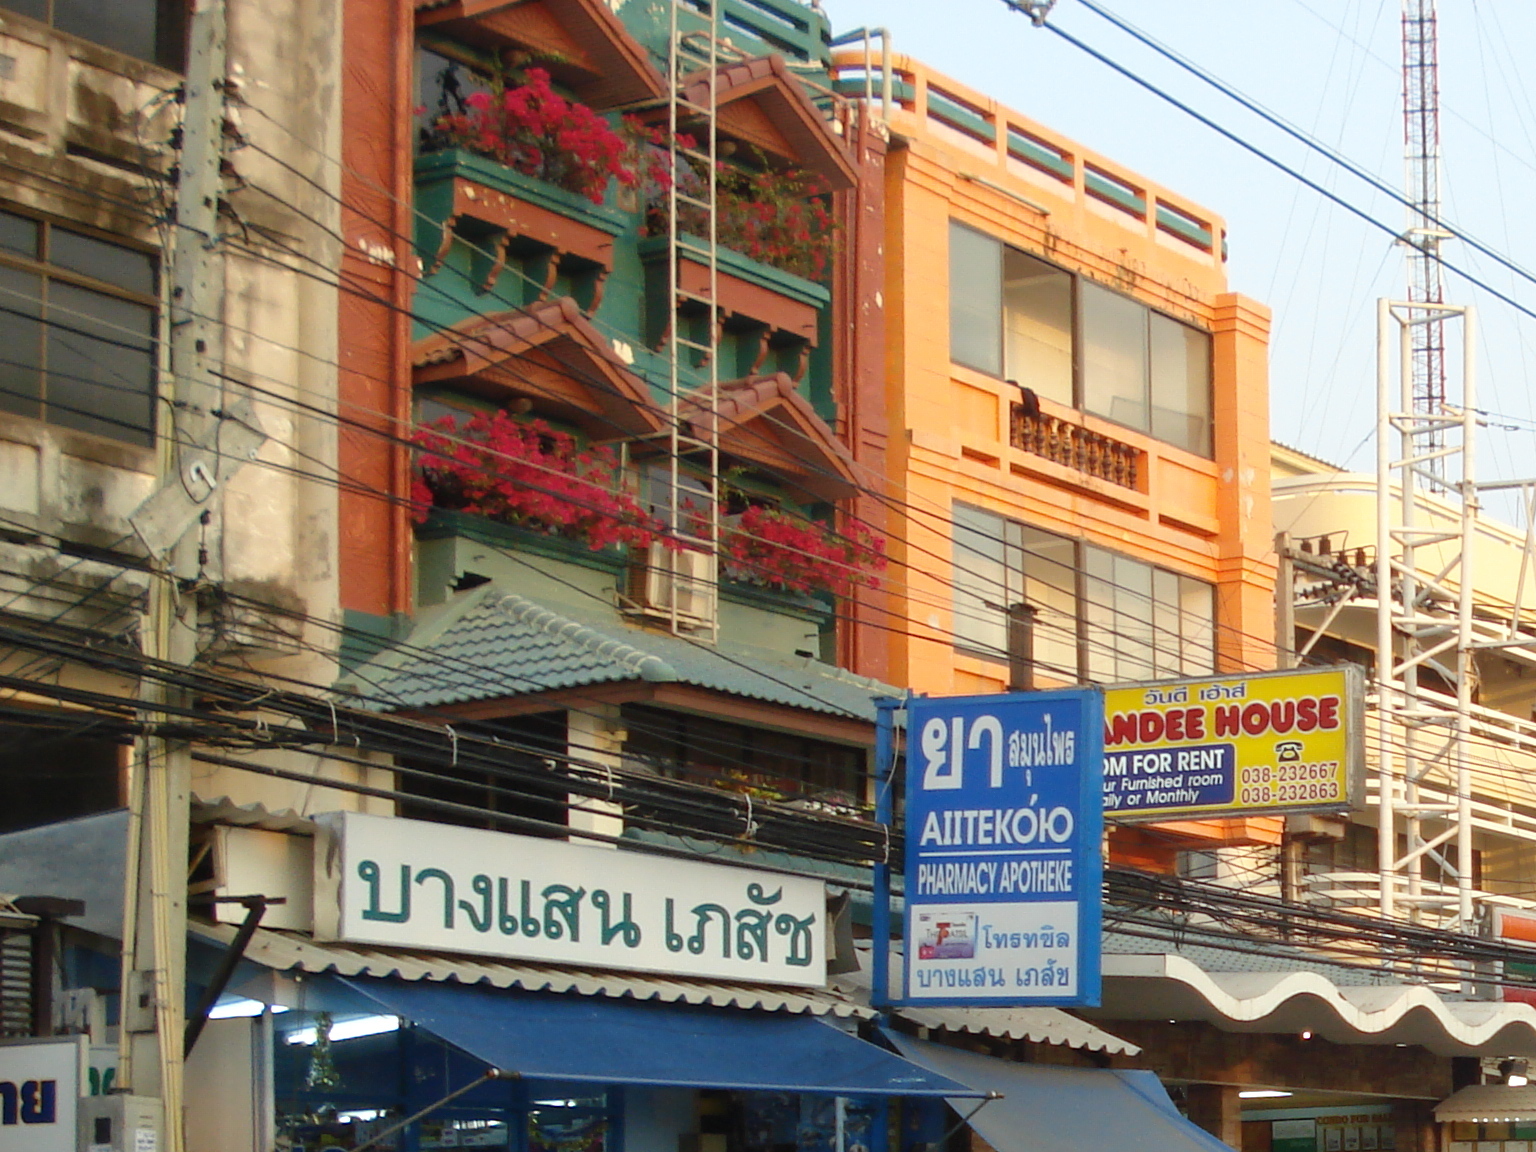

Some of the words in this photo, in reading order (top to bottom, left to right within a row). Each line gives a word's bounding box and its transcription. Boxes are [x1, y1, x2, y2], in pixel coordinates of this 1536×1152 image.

[1144, 686, 1188, 706] วันดี
[1214, 696, 1340, 738] HOUSE
[920, 714, 1004, 790] ยา
[1008, 712, 1075, 788] สมุนไพร
[1133, 754, 1174, 775] FOR
[1178, 749, 1225, 771] RENT
[1121, 774, 1183, 792] Furnished
[1187, 773, 1223, 788] room
[1241, 762, 1338, 786] 038-232667
[1127, 796, 1141, 806] or
[1146, 788, 1199, 806] Monthly
[1241, 782, 1338, 805] 038-232863
[918, 862, 997, 896] PHARMACY
[999, 859, 1073, 894] APOTHEKE
[357, 859, 642, 948] บางแสน
[664, 881, 817, 967] เภสัช
[916, 967, 1006, 989] บางแสน
